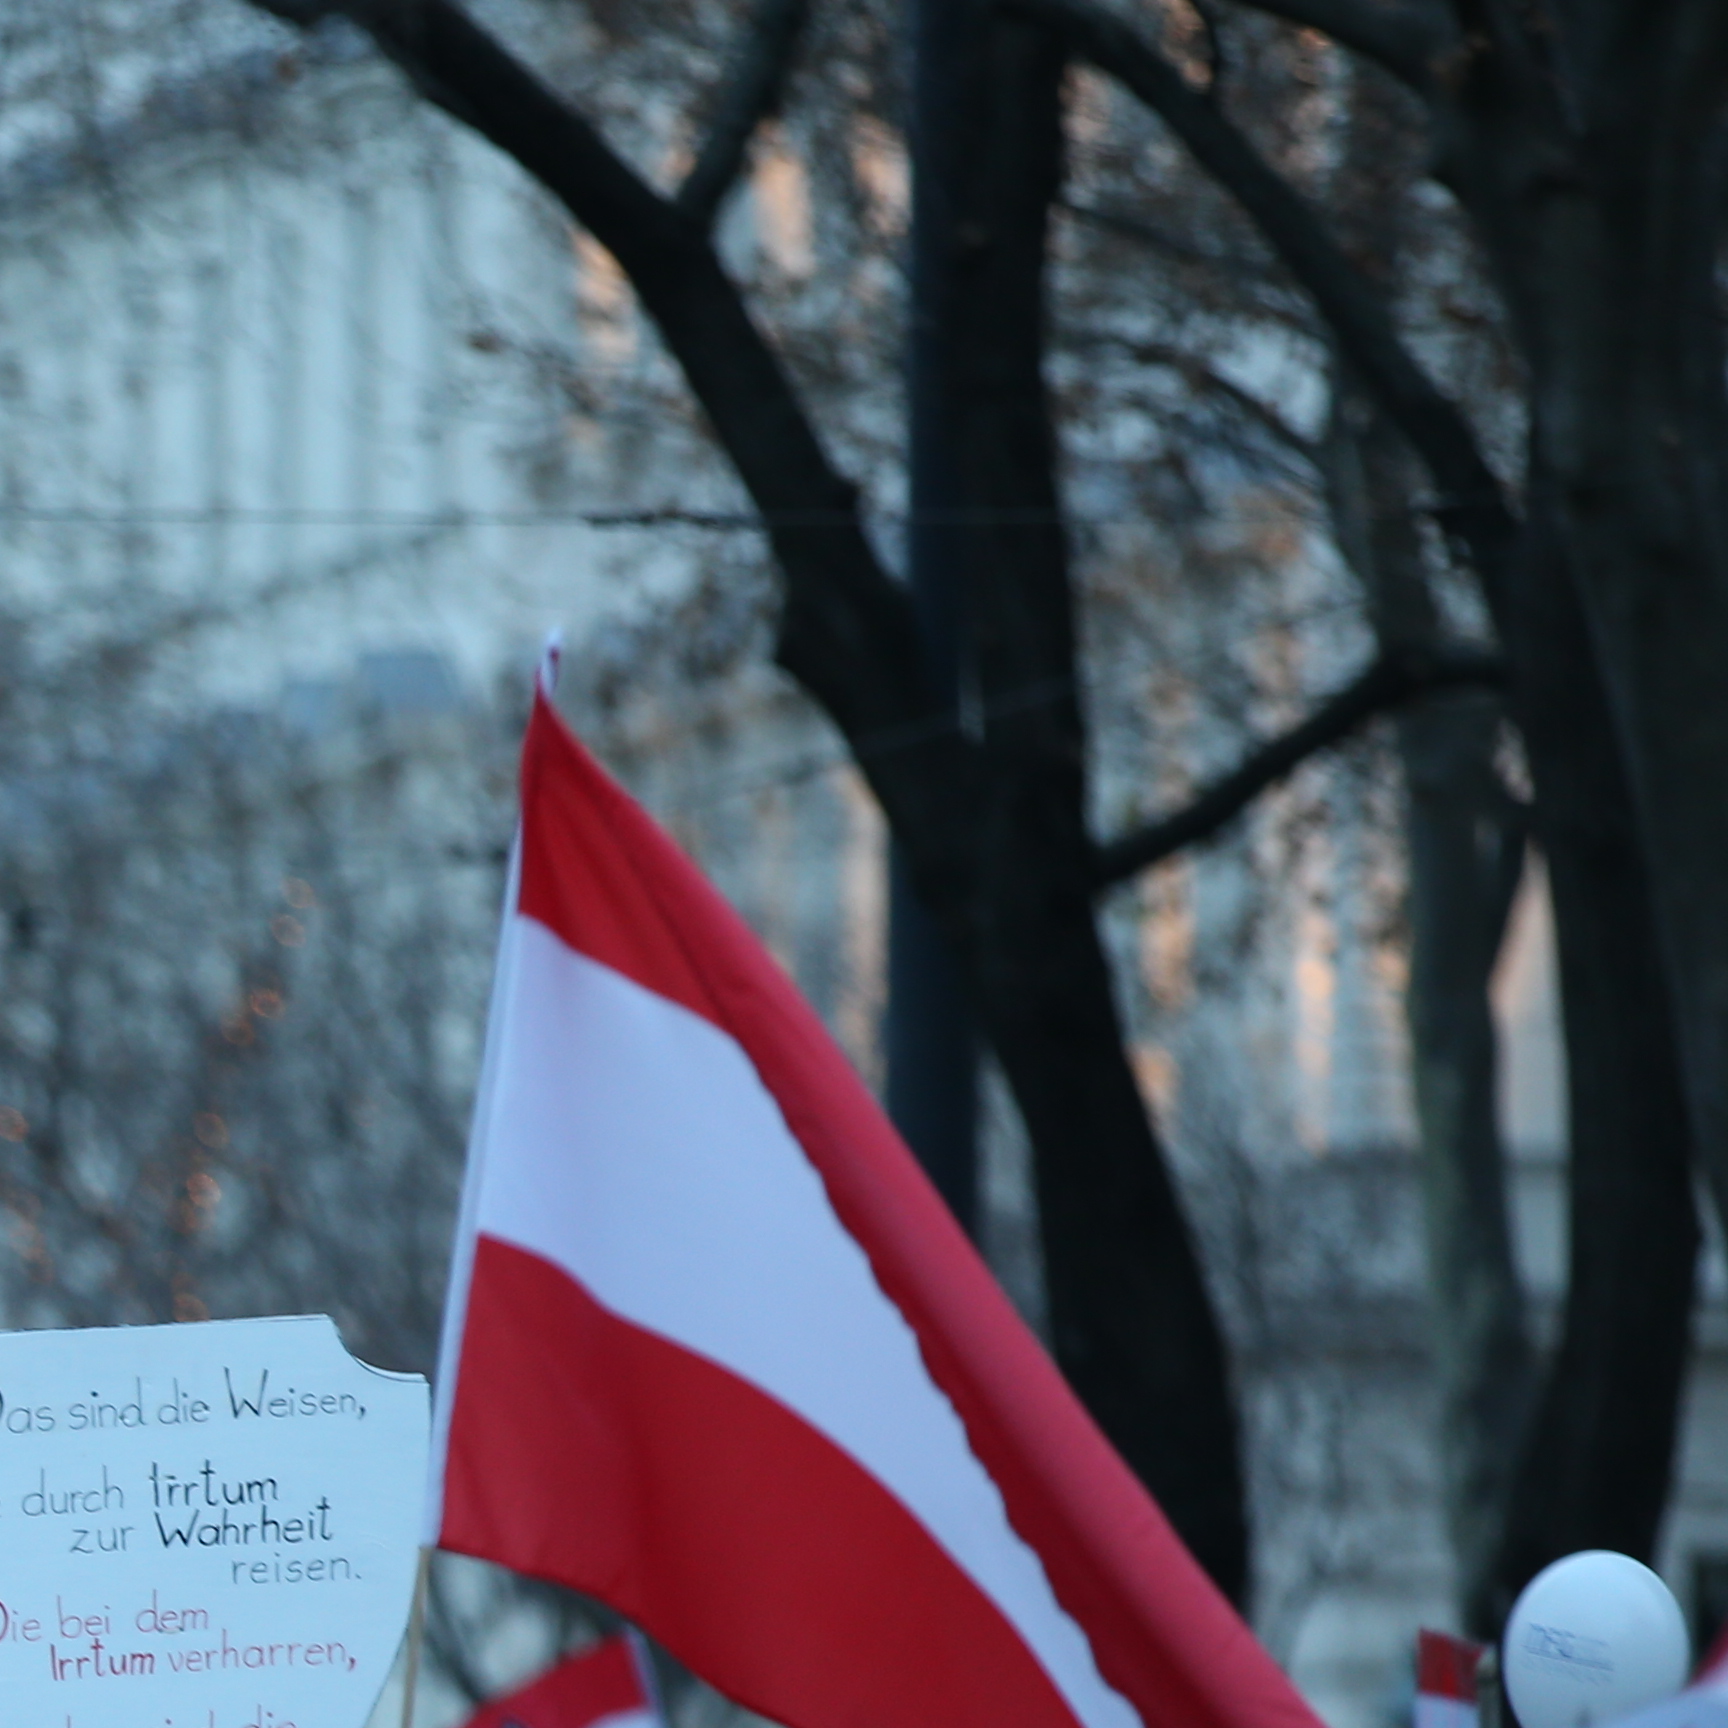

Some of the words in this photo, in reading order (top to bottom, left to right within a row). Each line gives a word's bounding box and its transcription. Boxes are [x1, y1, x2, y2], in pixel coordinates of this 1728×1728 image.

[69, 1375, 147, 1431] sind
[157, 1377, 211, 1425] die
[223, 1365, 367, 1421] Weisen,
[21, 1464, 125, 1517] durch
[68, 1525, 136, 1554] zur
[153, 1495, 333, 1549] Wahrheit
[231, 1551, 362, 1585] reisen.
[57, 1594, 111, 1640] bei
[135, 1588, 209, 1634] dem
[49, 1637, 155, 1682] Irrtum
[168, 1627, 357, 1673] verharren,
